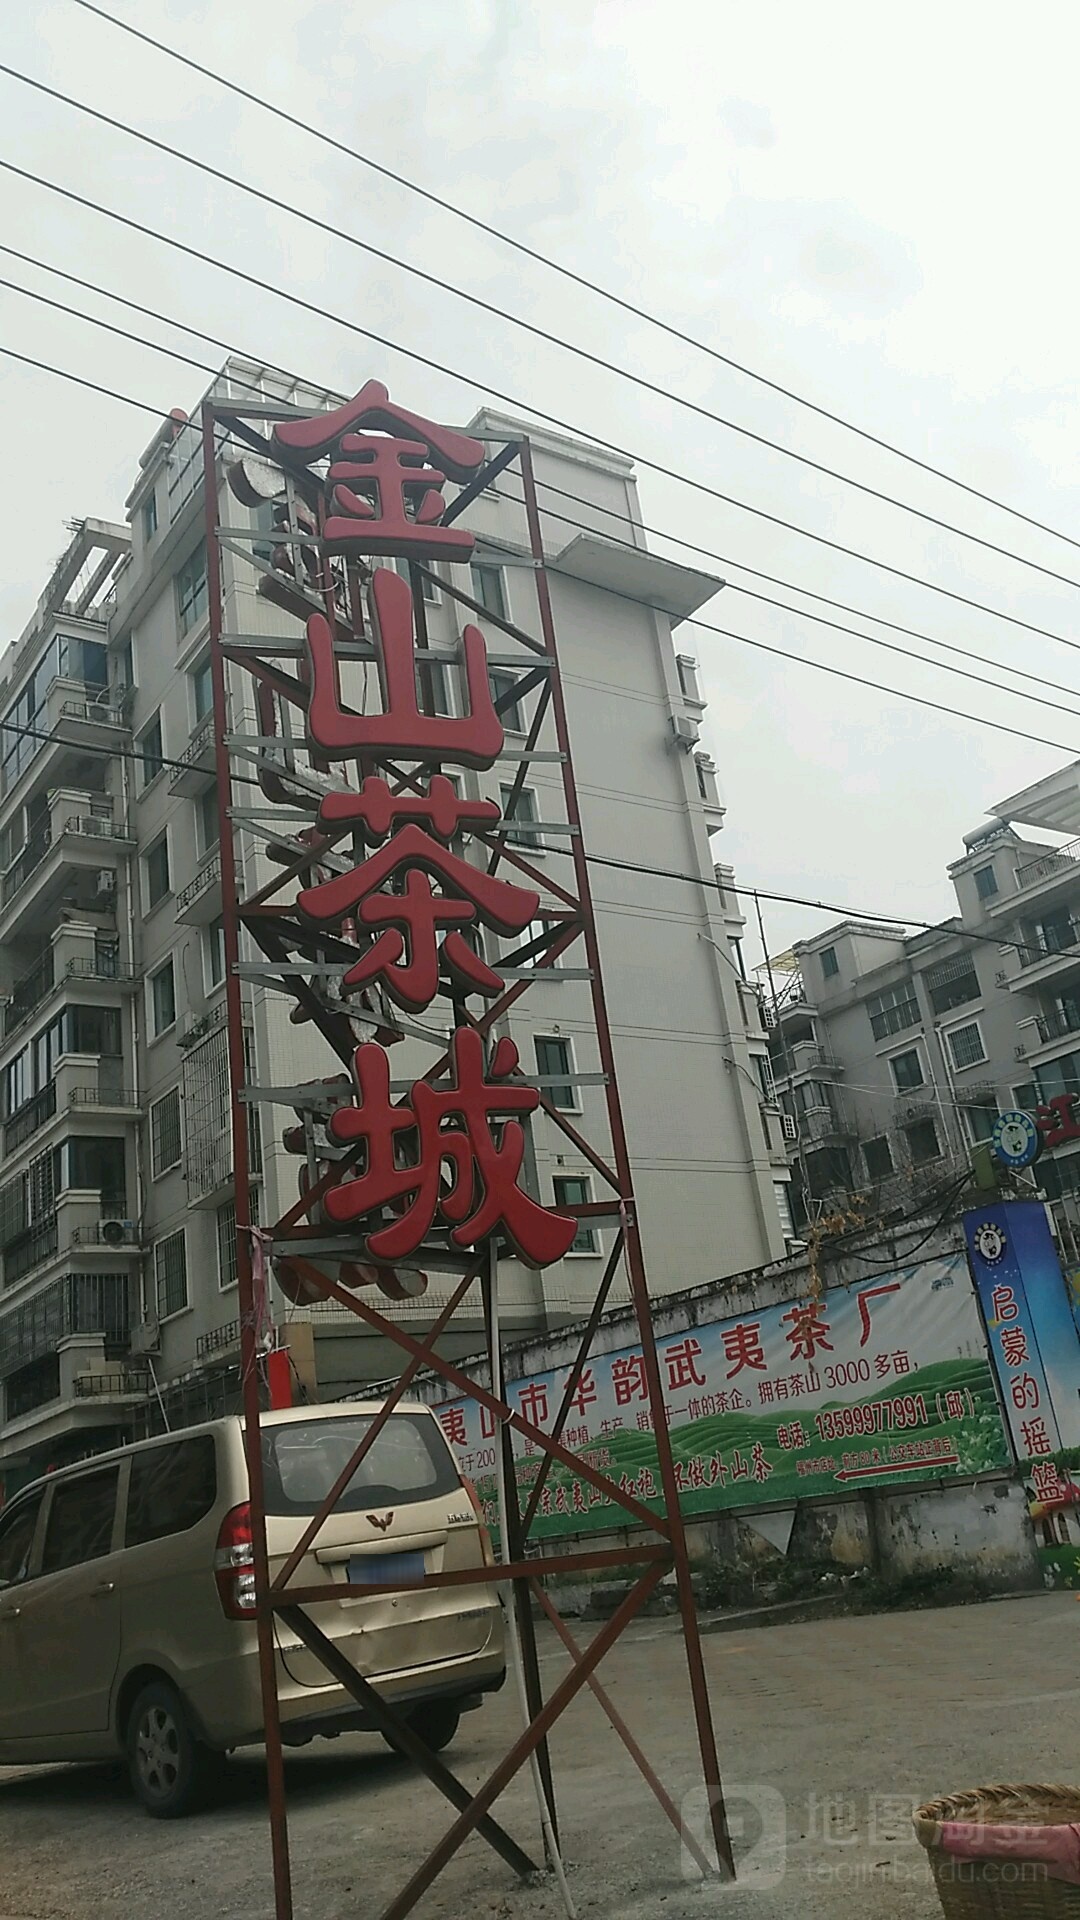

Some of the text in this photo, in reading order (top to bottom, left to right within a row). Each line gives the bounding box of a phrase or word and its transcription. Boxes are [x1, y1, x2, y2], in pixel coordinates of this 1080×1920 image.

[270, 379, 578, 1268] 金山茶城
[815, 1394, 929, 1441] 13599977991
[824, 1358, 871, 1389] 3000
[991, 1284, 1064, 1504] 启蒙的摇篮
